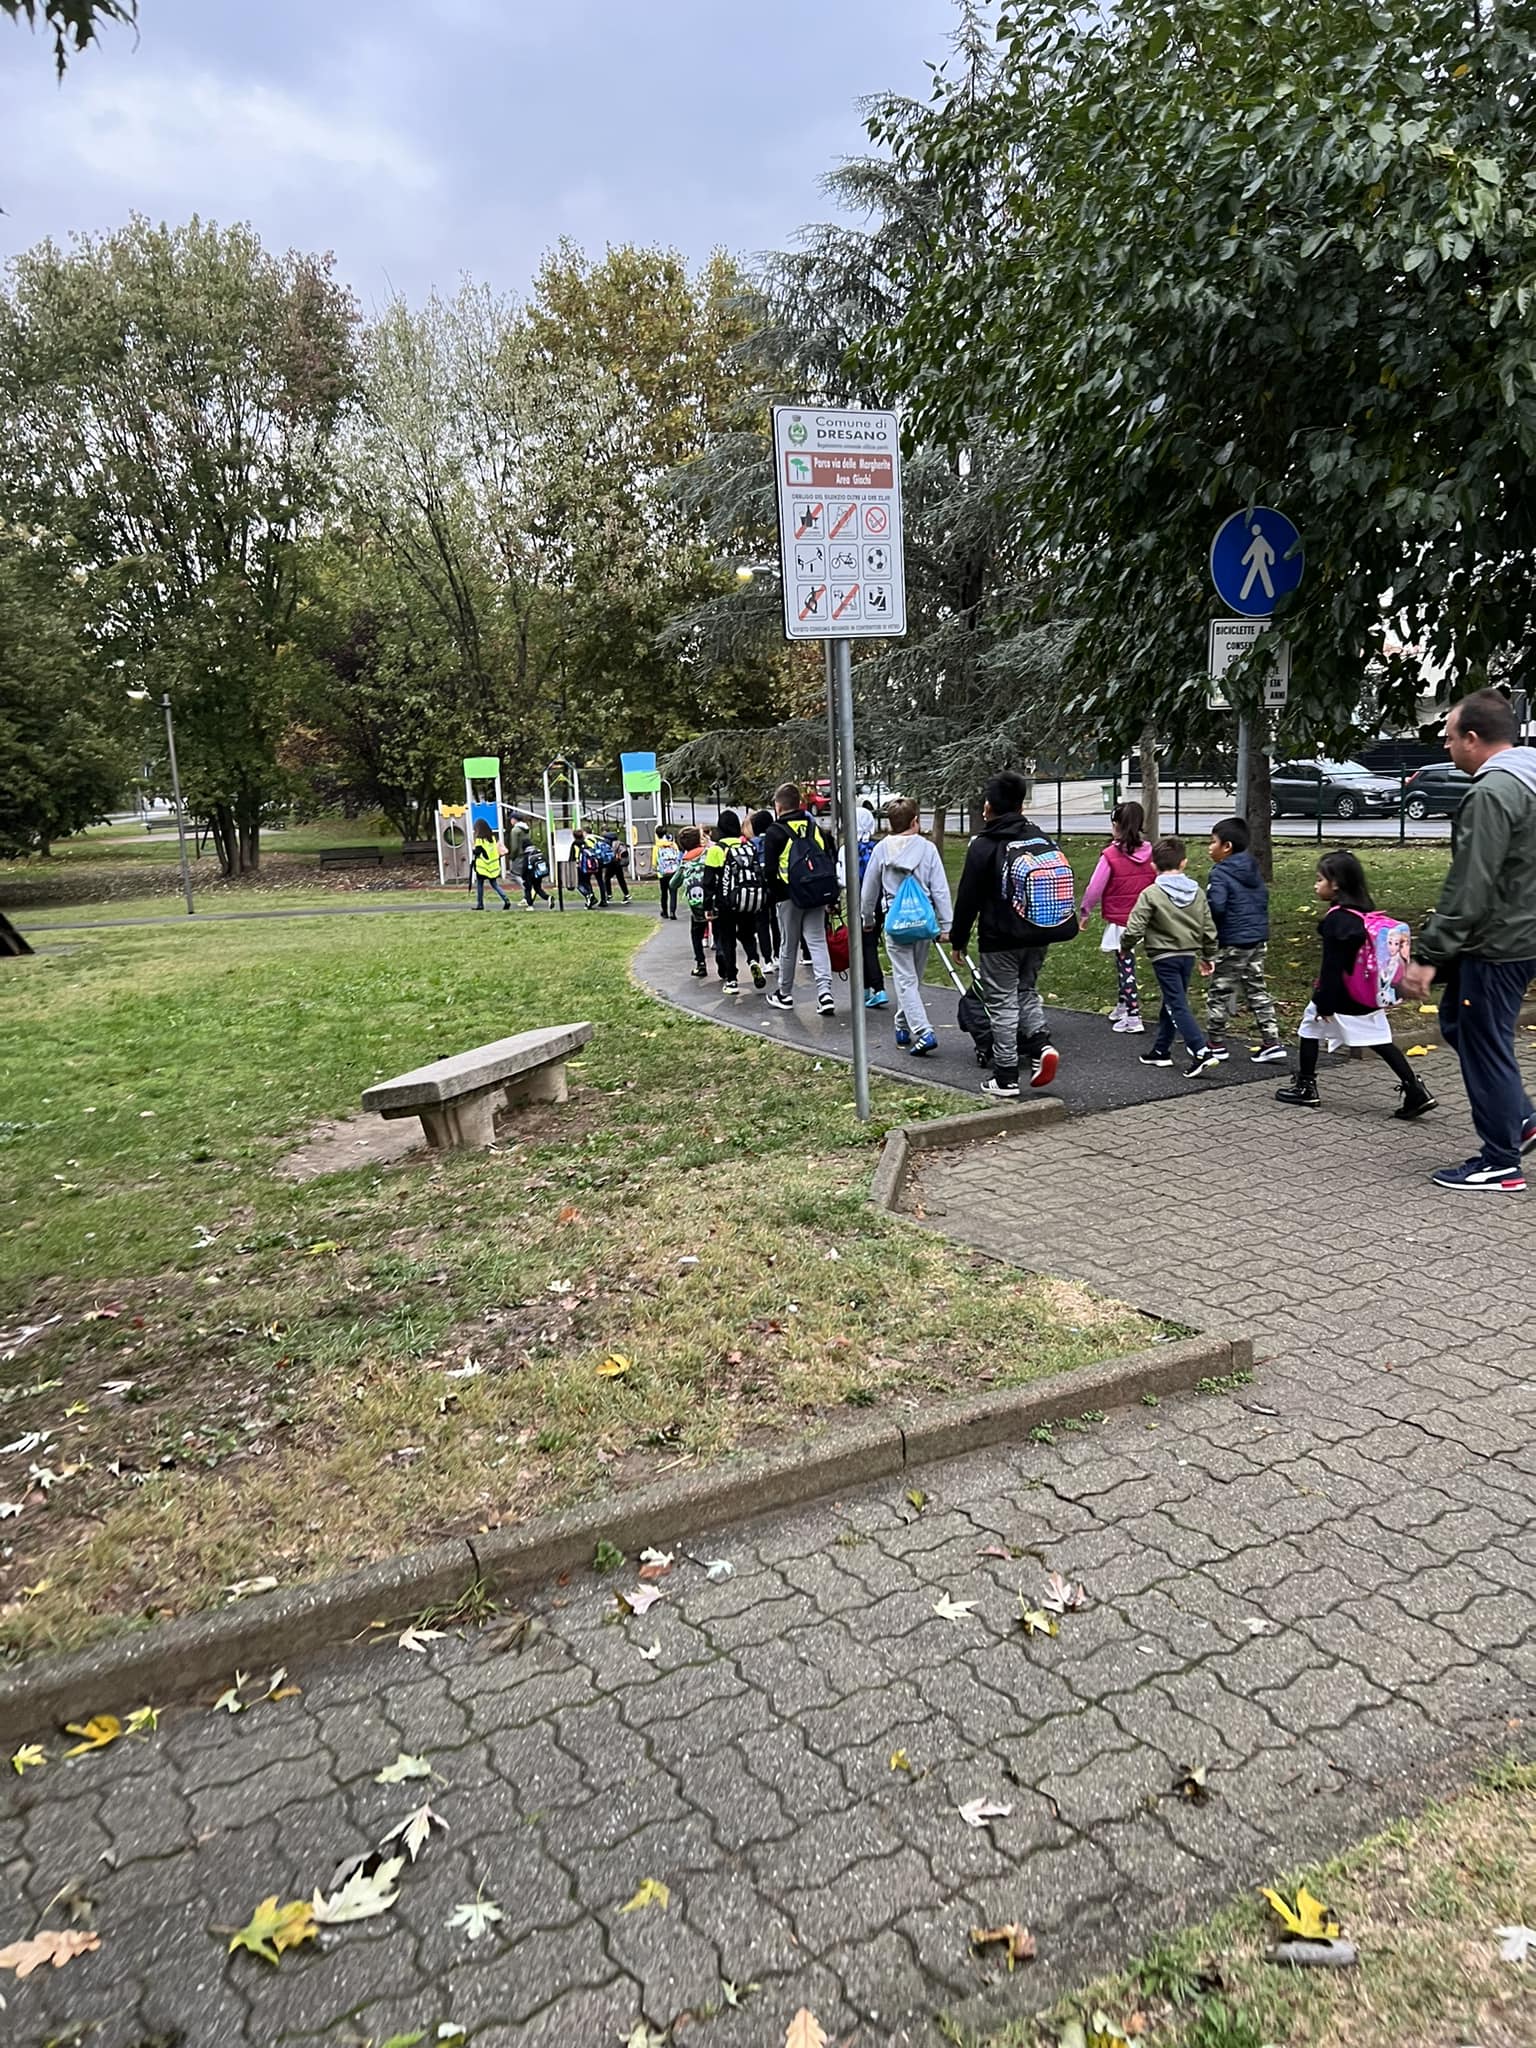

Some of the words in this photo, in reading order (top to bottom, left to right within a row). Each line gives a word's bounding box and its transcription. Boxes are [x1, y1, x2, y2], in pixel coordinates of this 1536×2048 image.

[815, 416, 871, 429] Comune
[875, 419, 887, 429] di
[817, 429, 887, 441] DRESANO
[814, 457, 831, 469] Parco
[832, 458, 841, 469] via
[842, 457, 857, 470] delle
[859, 458, 891, 473] Margherite
[836, 473, 850, 485] Area
[852, 474, 872, 486] Giochi
[1216, 626, 1255, 635] BICICLETTE
